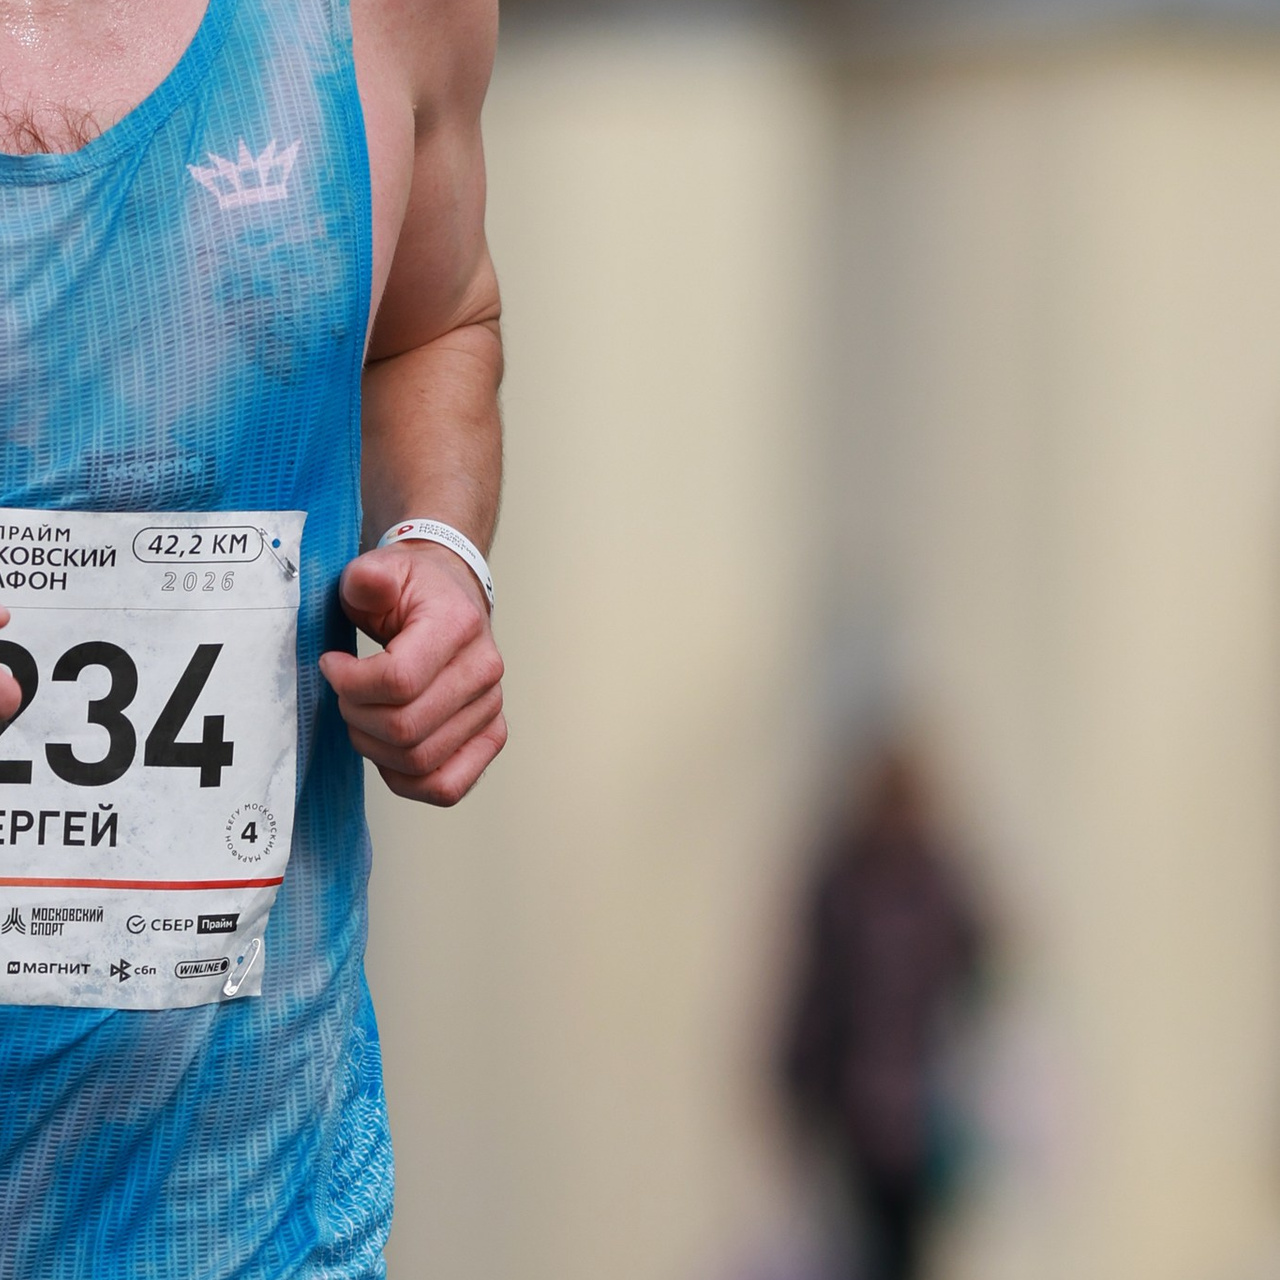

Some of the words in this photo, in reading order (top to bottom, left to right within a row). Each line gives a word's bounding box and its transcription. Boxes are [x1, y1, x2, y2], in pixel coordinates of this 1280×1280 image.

[147, 534, 203, 558] 42,2
[161, 571, 235, 592] 2026
[225, 808, 240, 831] БЕГУ
[241, 821, 258, 843] 4
[244, 803, 277, 855] МОСКОВСКИЙ
[225, 835, 261, 863] МАРАФОН
[31, 906, 104, 922] МОСКОВСКИЙ
[30, 922, 65, 936] СПОРТ
[151, 919, 194, 931] СБЕР
[202, 918, 233, 931] Прайм
[23, 962, 91, 974] магнит
[134, 965, 157, 975] сбп
[180, 962, 221, 975] WINLINE
